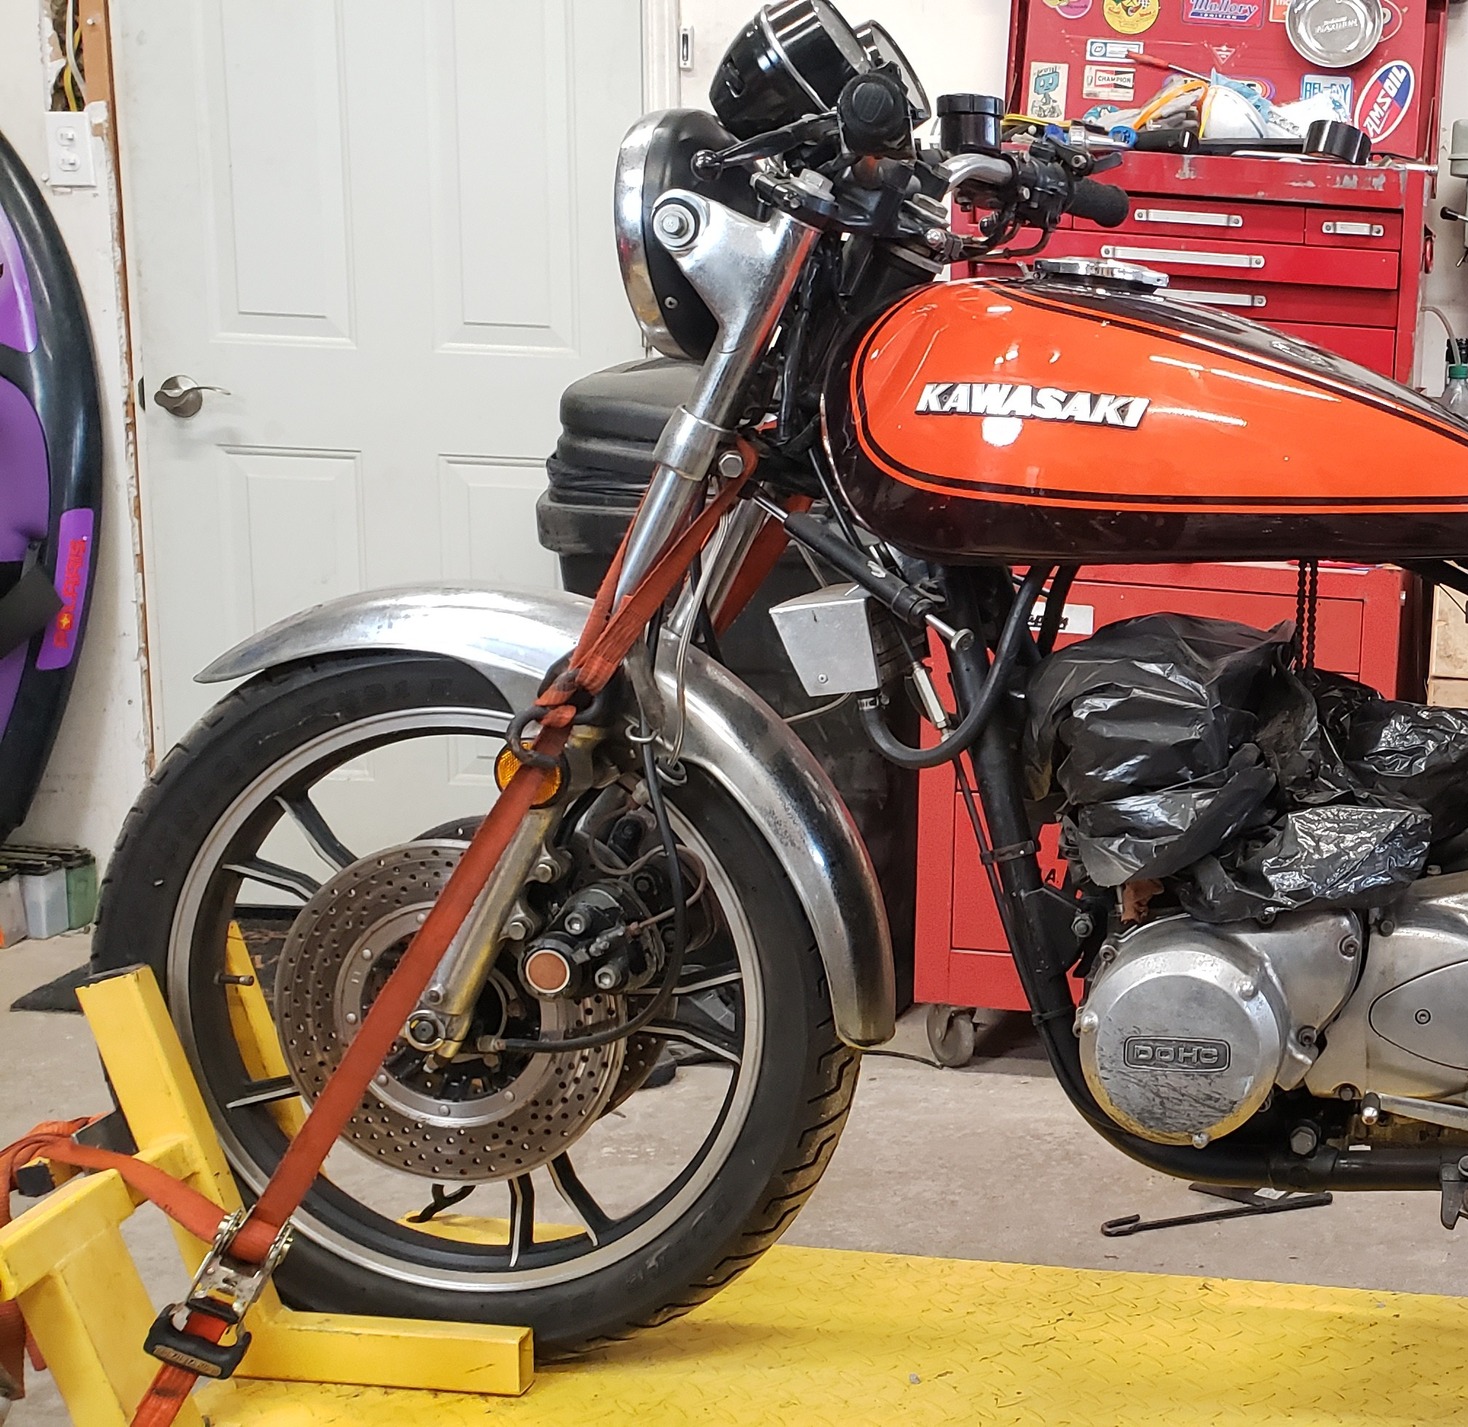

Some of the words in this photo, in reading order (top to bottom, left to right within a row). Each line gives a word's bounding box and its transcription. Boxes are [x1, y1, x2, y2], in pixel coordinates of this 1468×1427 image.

[1190, 0, 1258, 14] Mallory
[1097, 75, 1132, 84] CHAMPION
[1363, 66, 1407, 138] AMSOIL
[915, 382, 1151, 429] KAWASAKI
[1134, 1044, 1219, 1065] DOHC
